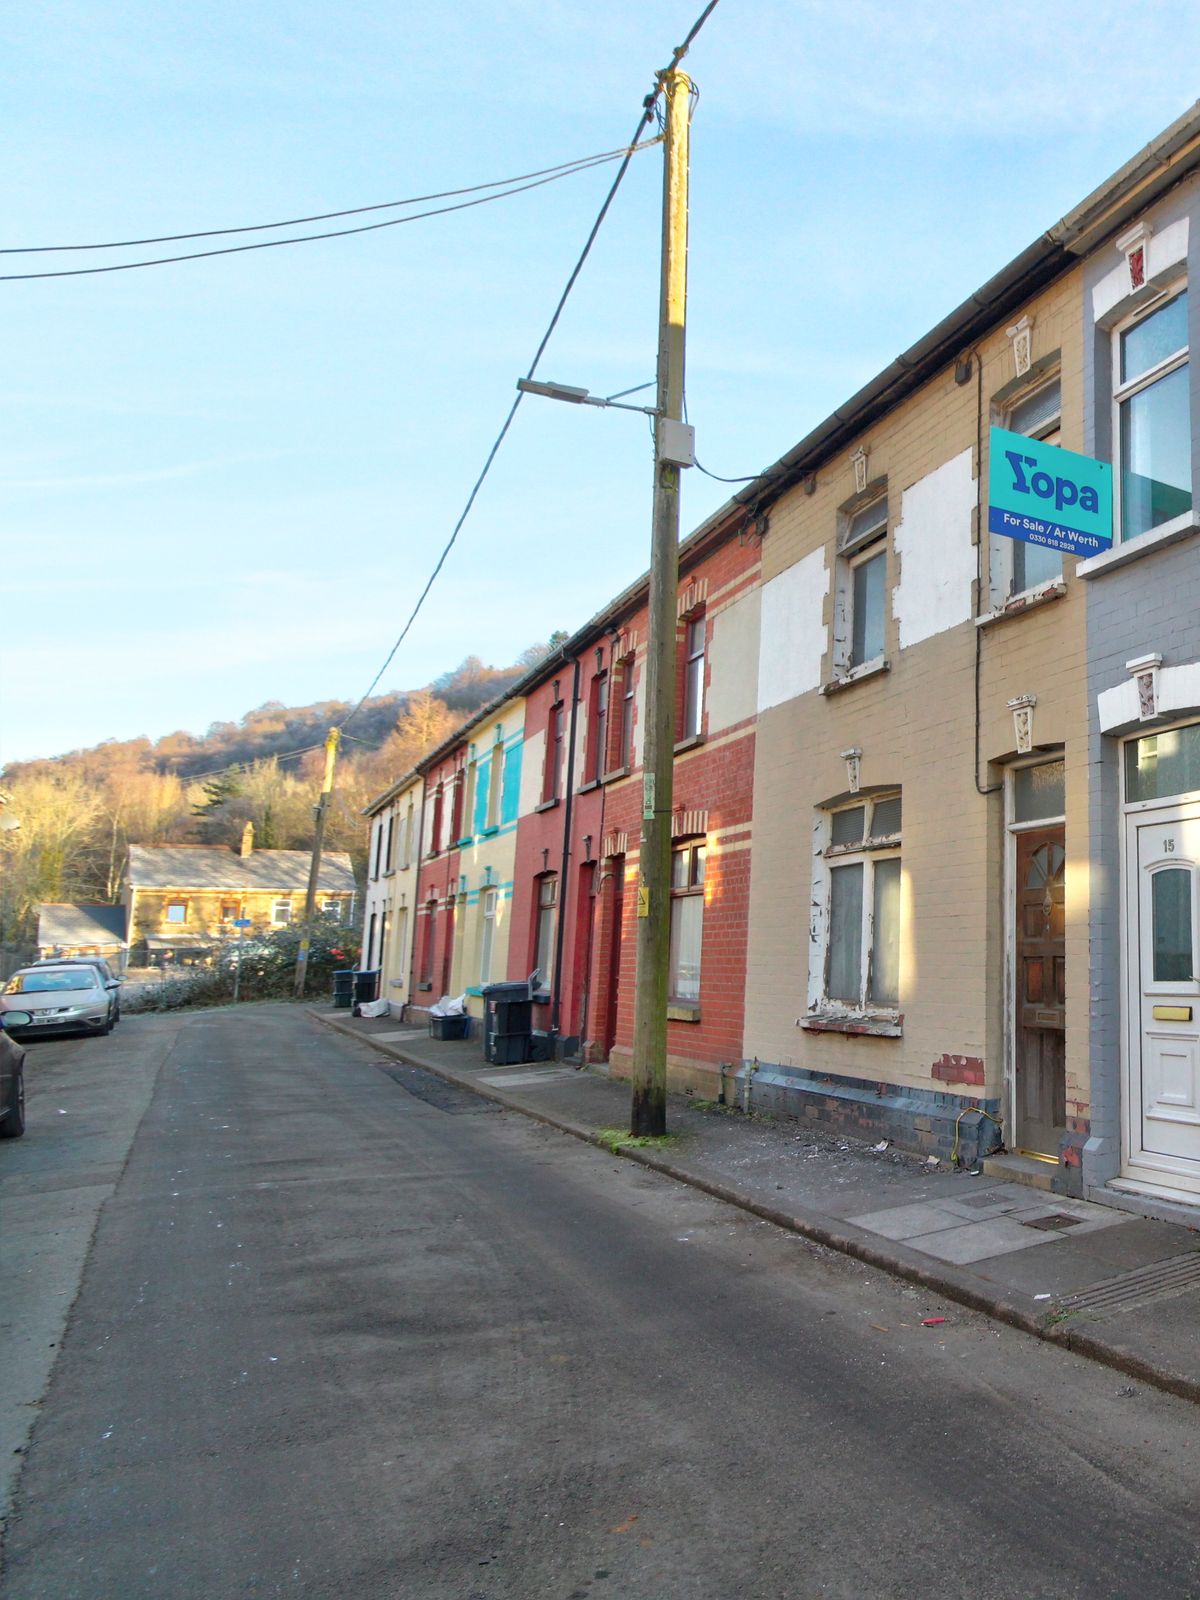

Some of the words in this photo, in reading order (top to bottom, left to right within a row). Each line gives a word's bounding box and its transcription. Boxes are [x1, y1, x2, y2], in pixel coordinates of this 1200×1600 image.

[1005, 450, 1099, 514] Yopa
[1003, 513, 1021, 526] For
[1023, 518, 1045, 532] Sale
[1046, 525, 1052, 534] /
[1054, 527, 1066, 539] Ar
[1067, 530, 1099, 548] Werth
[1029, 533, 1047, 543] 0330
[1163, 838, 1175, 853] 15
